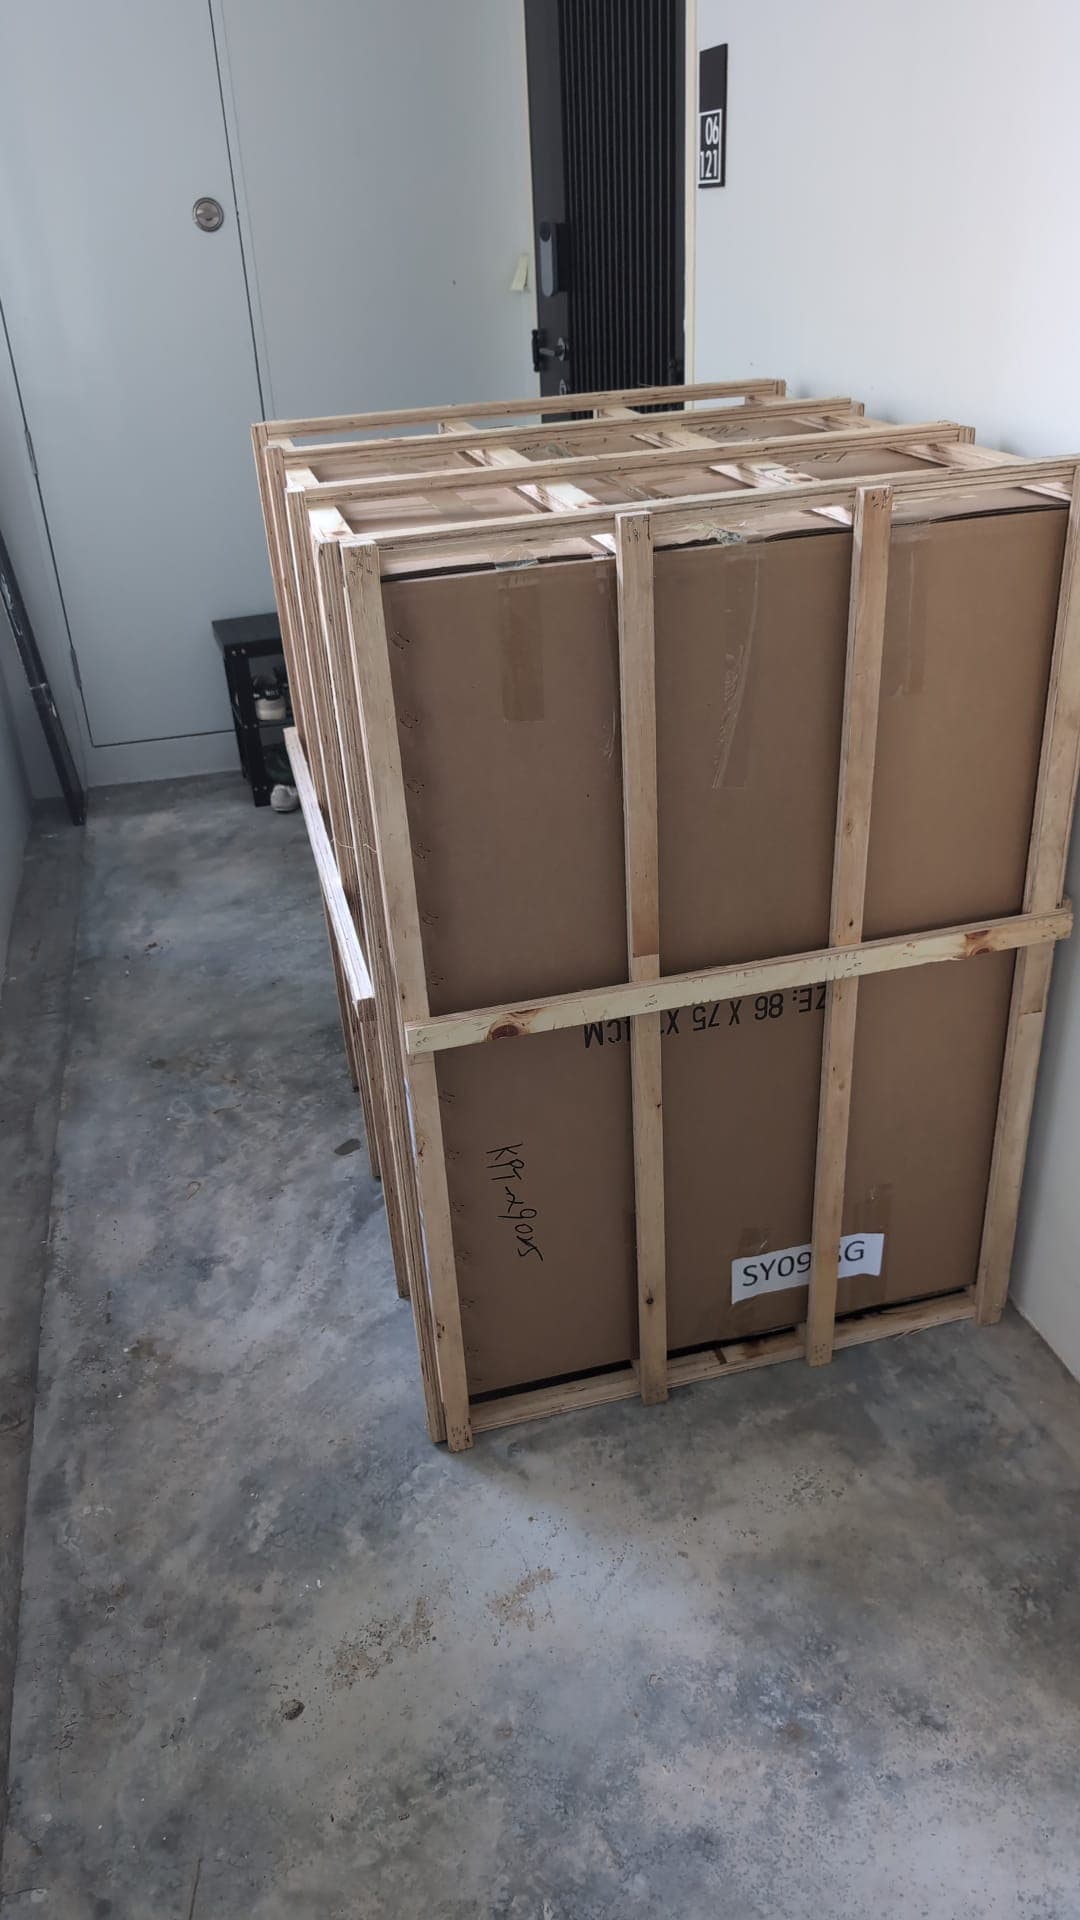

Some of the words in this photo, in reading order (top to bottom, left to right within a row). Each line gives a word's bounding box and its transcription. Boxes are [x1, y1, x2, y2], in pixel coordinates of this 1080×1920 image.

[705, 116, 719, 145] 06
[700, 149, 718, 178] 121
[692, 1003, 720, 1031] 75
[728, 1000, 743, 1025] X
[755, 992, 784, 1021] 86
